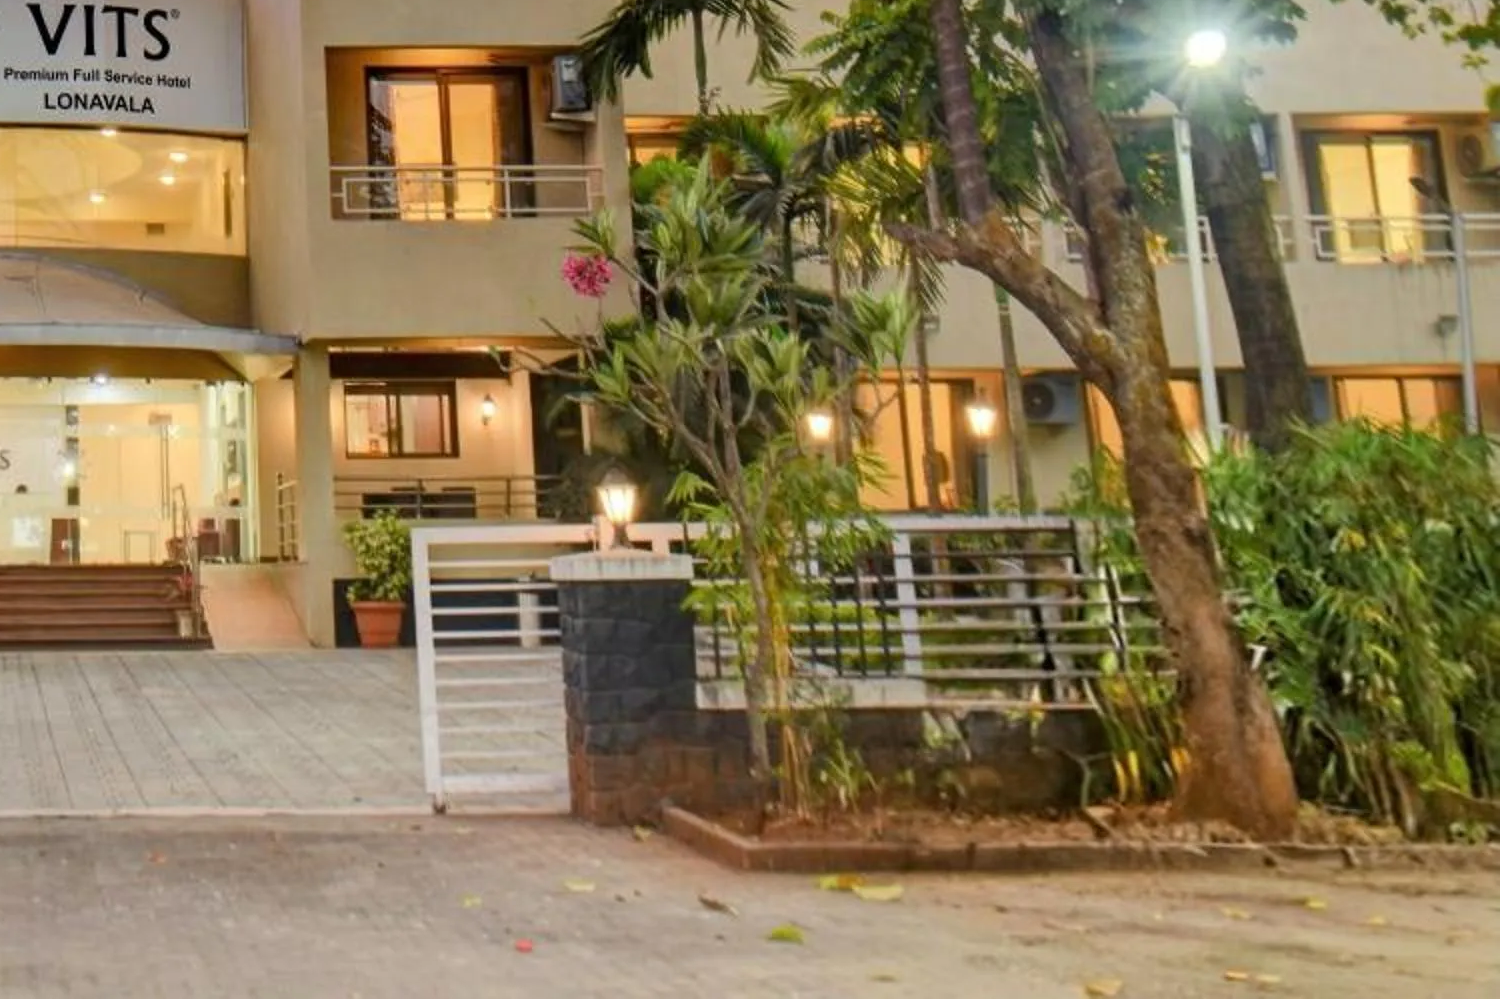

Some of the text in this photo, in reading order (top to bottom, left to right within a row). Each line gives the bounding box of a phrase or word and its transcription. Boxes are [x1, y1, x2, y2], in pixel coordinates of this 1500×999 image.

[3, 67, 192, 89] Premium Full Service Hotel
[44, 92, 156, 114] LONAVALA
